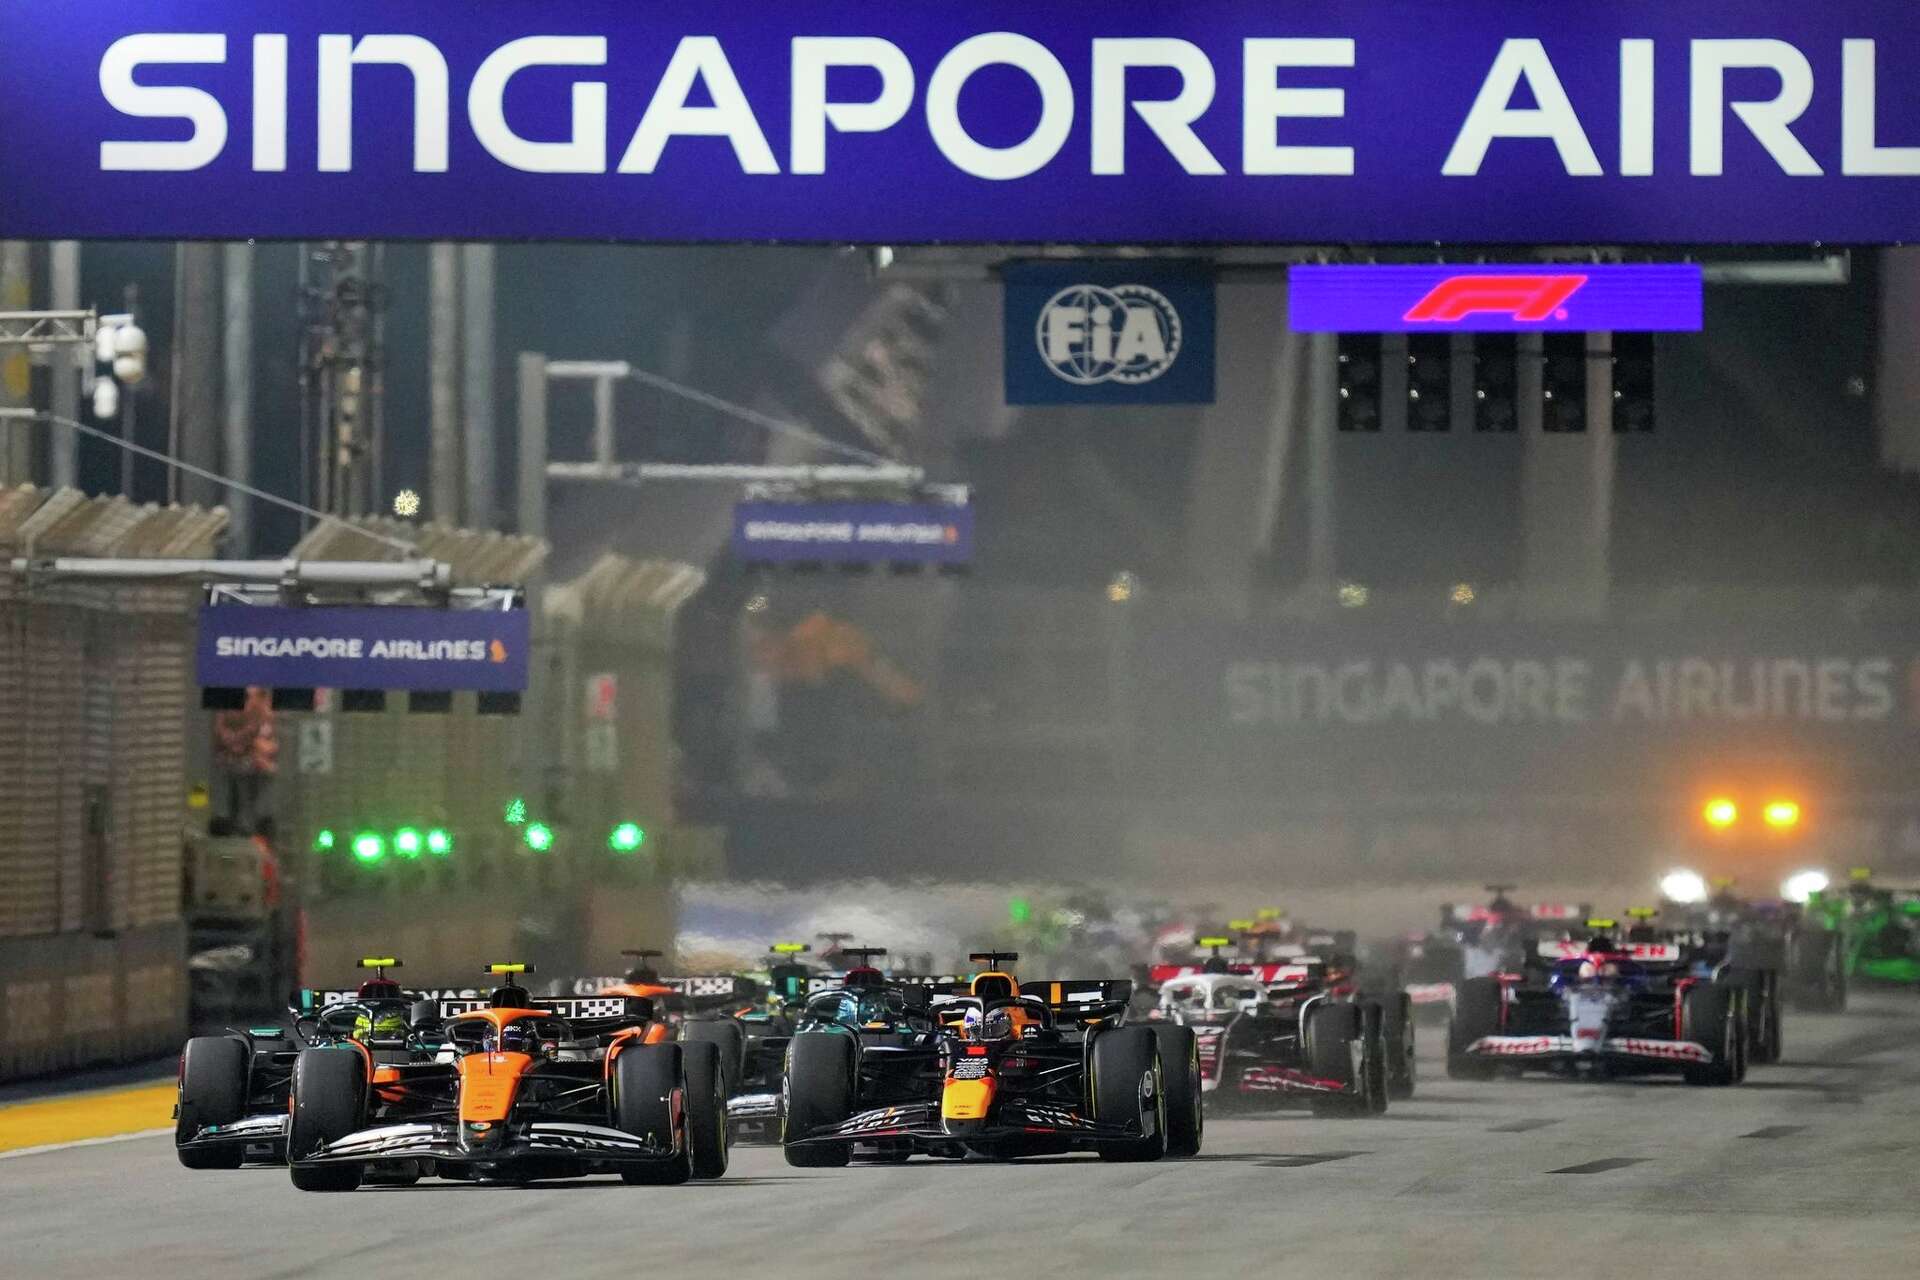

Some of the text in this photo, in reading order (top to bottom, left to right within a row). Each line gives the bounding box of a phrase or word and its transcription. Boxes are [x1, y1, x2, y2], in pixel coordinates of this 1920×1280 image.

[98, 31, 1355, 179] SINGAPORE
[1402, 274, 1588, 321] F1
[216, 635, 487, 661] SINGAPORE AIRLINES
